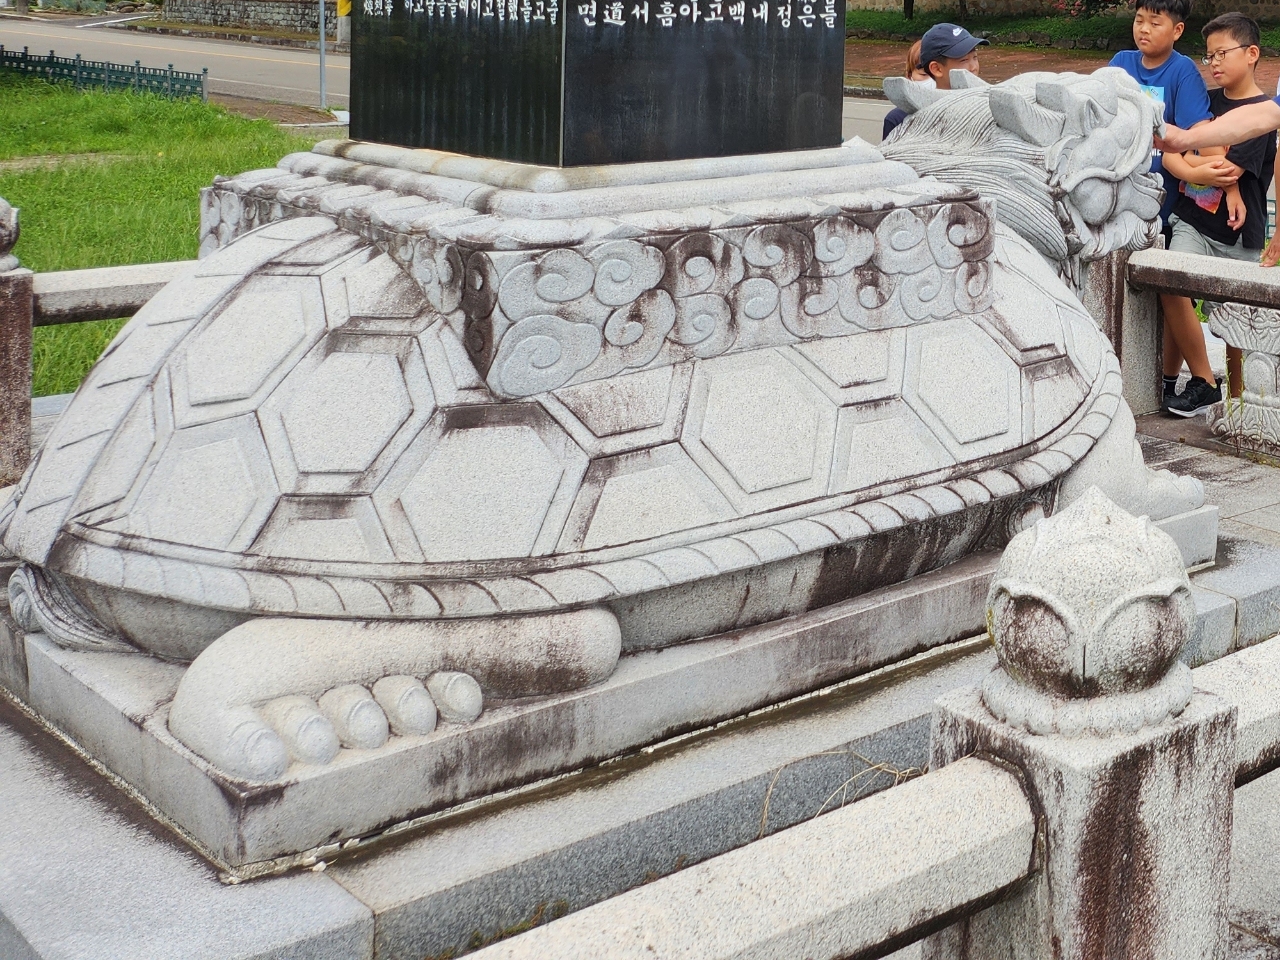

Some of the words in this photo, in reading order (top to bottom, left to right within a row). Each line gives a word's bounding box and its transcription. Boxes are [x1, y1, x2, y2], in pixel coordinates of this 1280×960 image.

[656, 1, 677, 27] 흠
[729, 1, 745, 25] 백
[752, 1, 768, 26] 내
